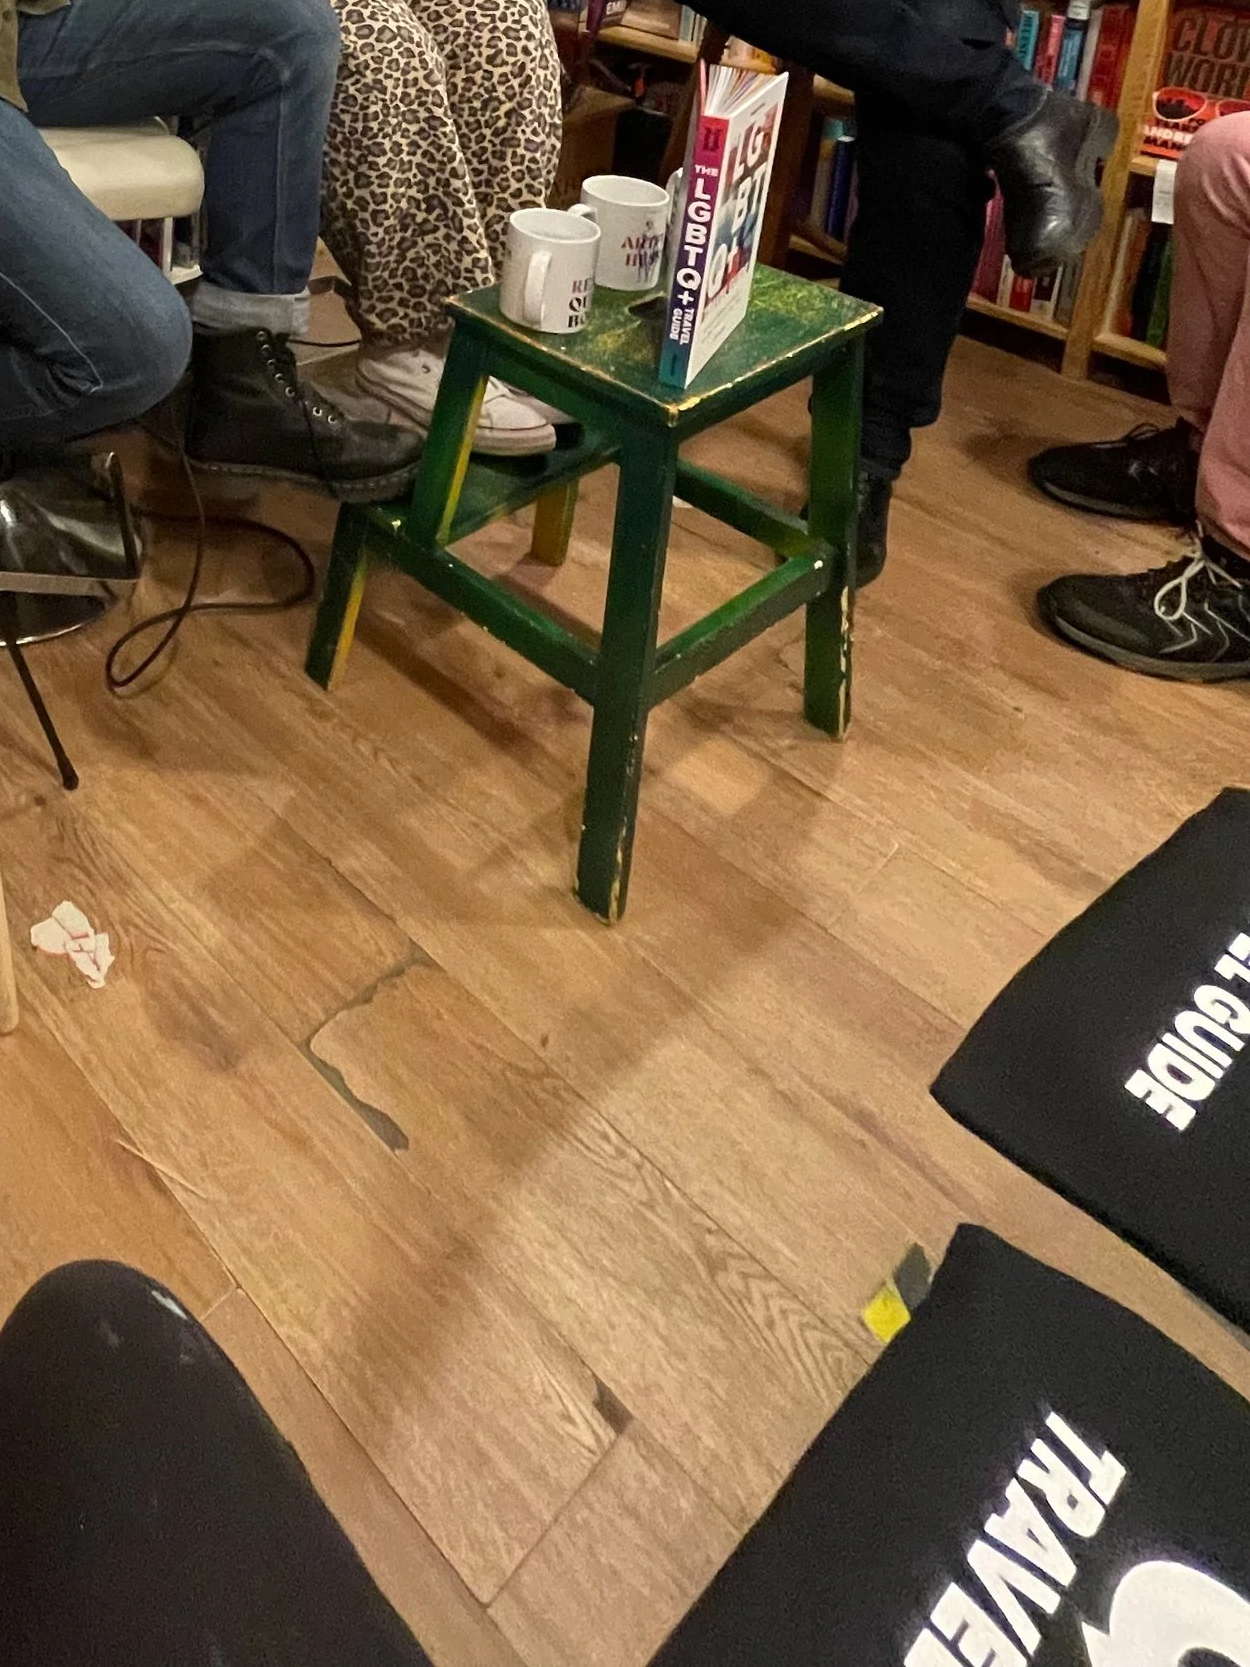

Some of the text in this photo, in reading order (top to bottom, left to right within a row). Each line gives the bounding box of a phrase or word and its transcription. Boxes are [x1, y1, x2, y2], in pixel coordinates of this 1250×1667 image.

[695, 164, 719, 177] THE
[669, 308, 684, 342] GUIDE
[679, 308, 696, 346] TRAVEL
[1124, 985, 1250, 1131] GUIDE
